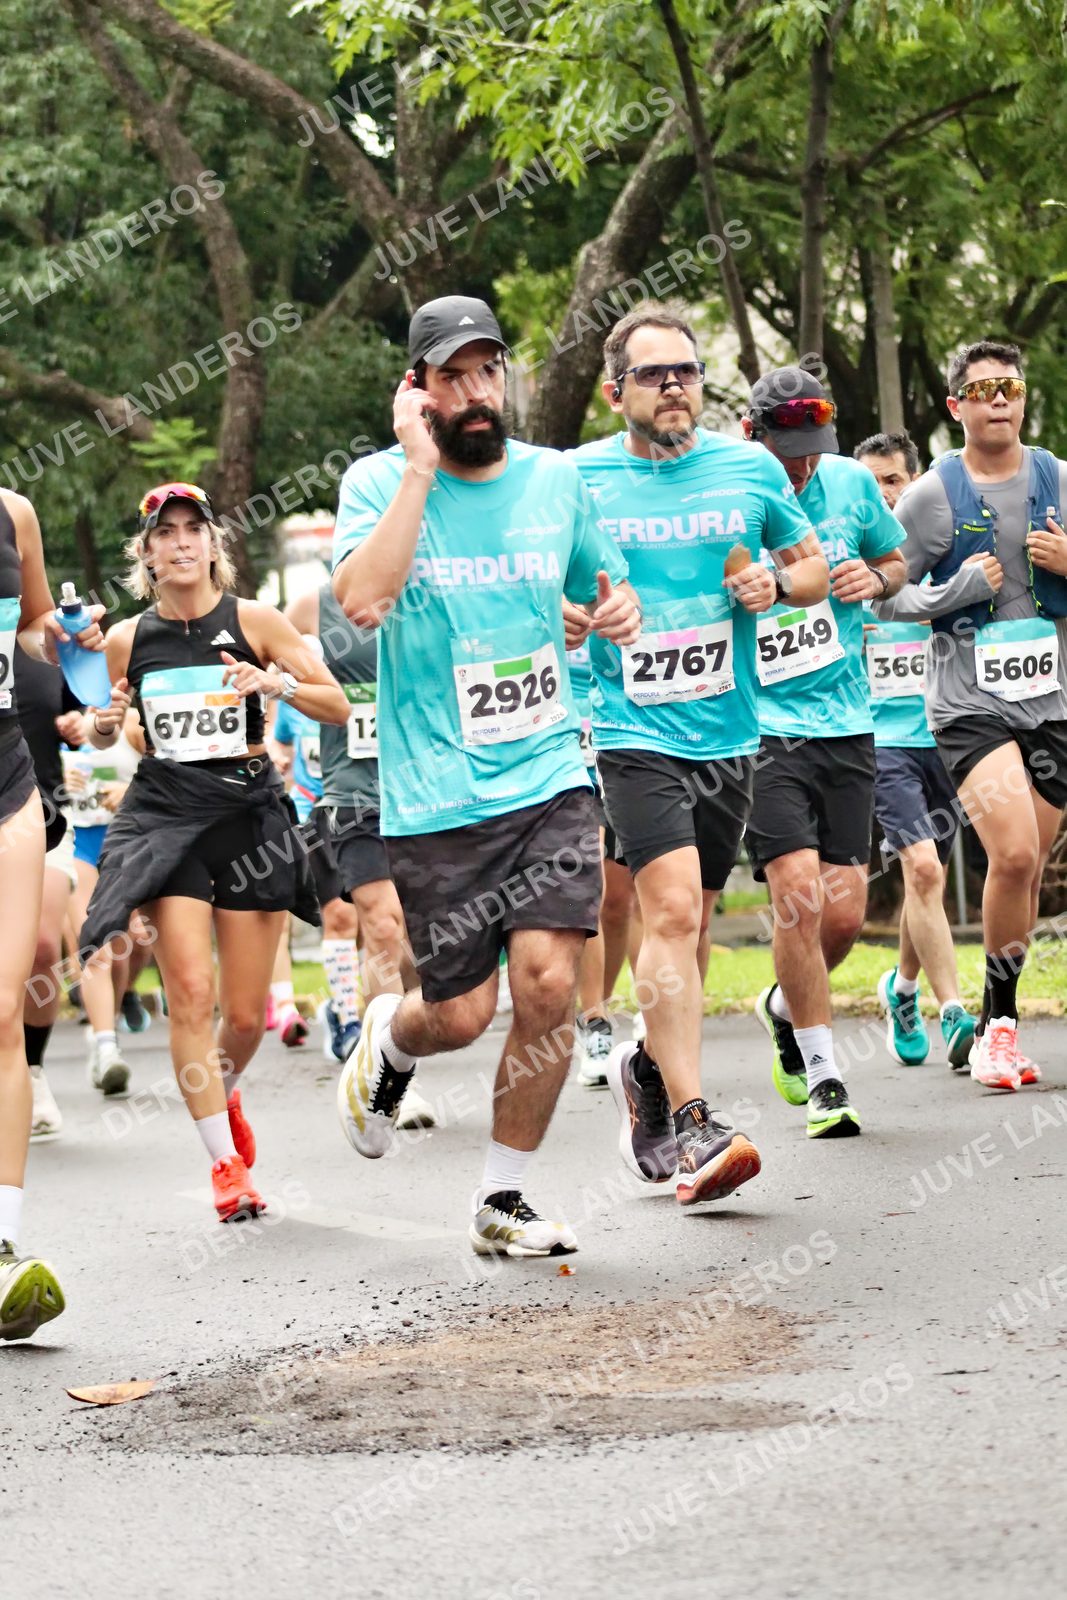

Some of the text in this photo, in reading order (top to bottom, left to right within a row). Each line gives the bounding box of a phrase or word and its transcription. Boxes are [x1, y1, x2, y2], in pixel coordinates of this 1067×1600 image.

[604, 509, 747, 543] ERDURA
[409, 551, 560, 587] PERDURA
[757, 618, 832, 662] 5249
[631, 640, 727, 682] 2767
[984, 652, 1053, 682] 5606
[467, 665, 557, 718] 2926
[154, 707, 239, 740] 6786
